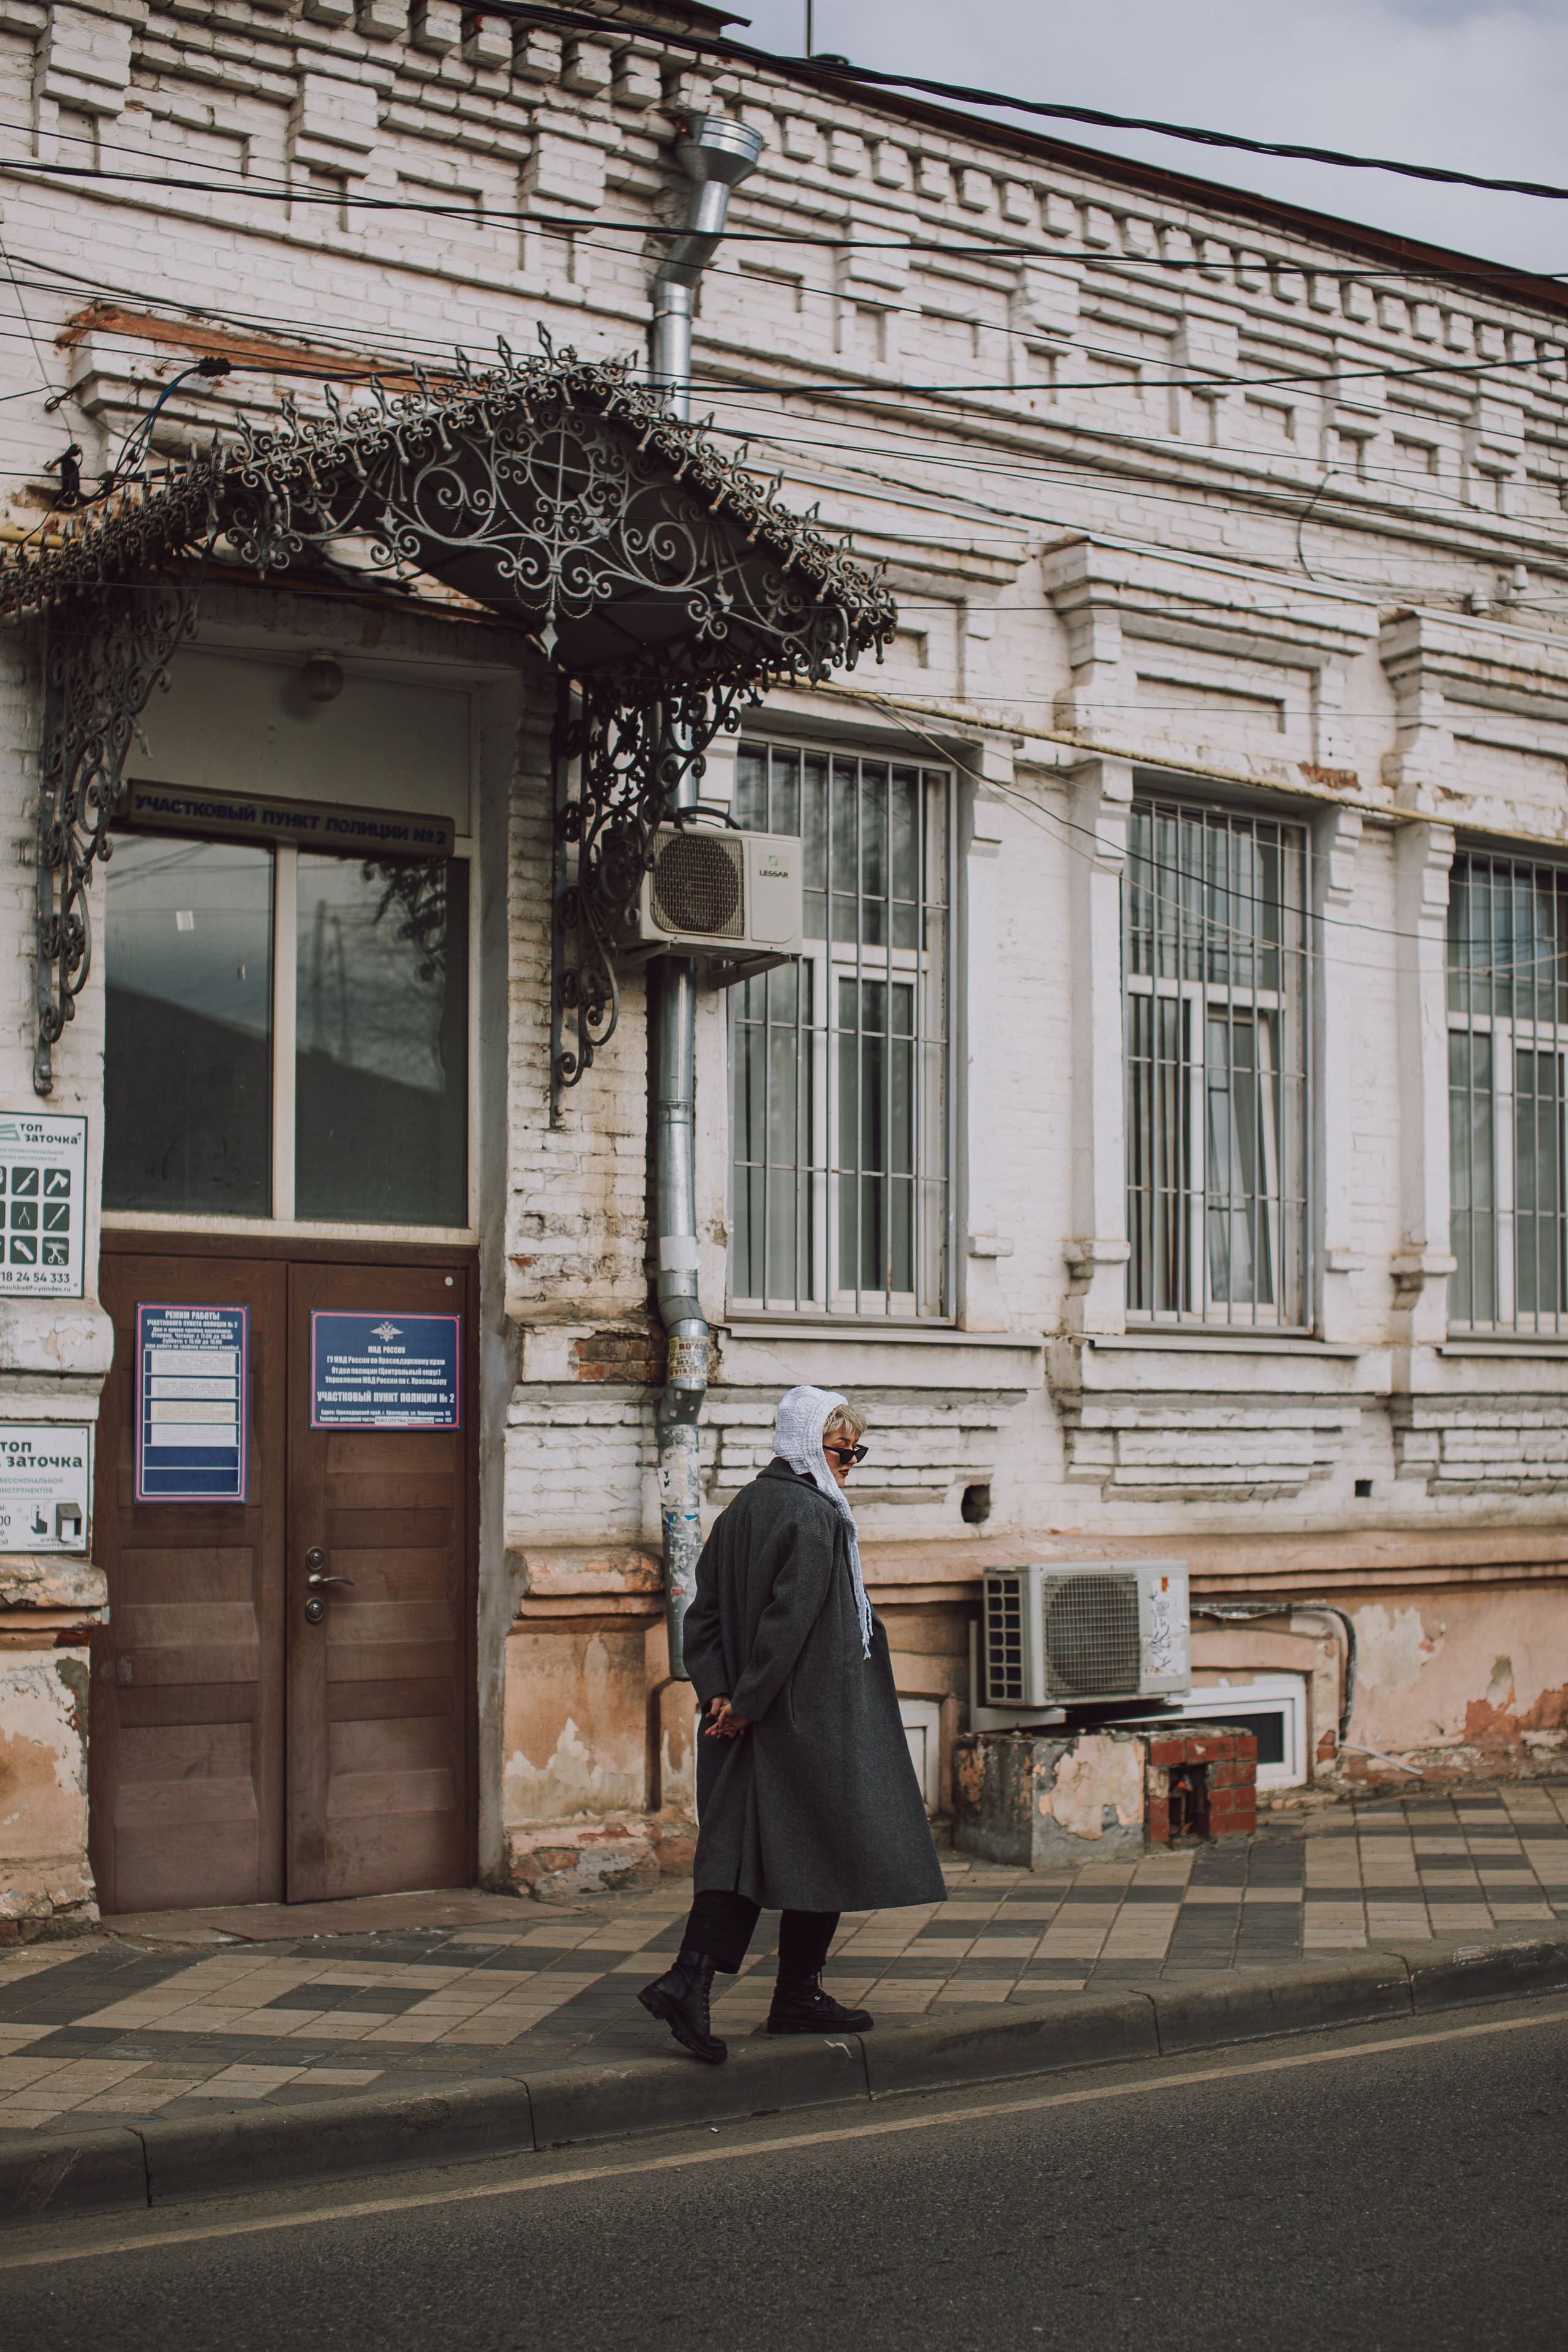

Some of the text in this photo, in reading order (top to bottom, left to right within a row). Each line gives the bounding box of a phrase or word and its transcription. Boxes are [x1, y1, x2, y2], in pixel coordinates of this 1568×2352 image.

[135, 794, 257, 822] УЧАСТКОВЫЙ
[262, 810, 320, 831] ПУНКТ
[326, 817, 409, 841] ПОЛИЦИИ
[760, 869, 788, 878] LESSAR
[17, 1272, 29, 1282] 24
[34, 1272, 47, 1283] 54
[50, 1273, 70, 1283] 333
[165, 1310, 220, 1321] РЕЖИМ РАБОТЫ
[334, 1355, 348, 1364] МВД
[379, 1357, 429, 1366] Краснодарскому
[331, 1366, 350, 1375] Отдел
[378, 1367, 421, 1376] (Центральный
[362, 1376, 375, 1385] МВД
[412, 1377, 447, 1386] Краснодару
[317, 1390, 455, 1404] УЧАСТКОВЫЙ ПУНКТ ПОЛИЦИИ № 2
